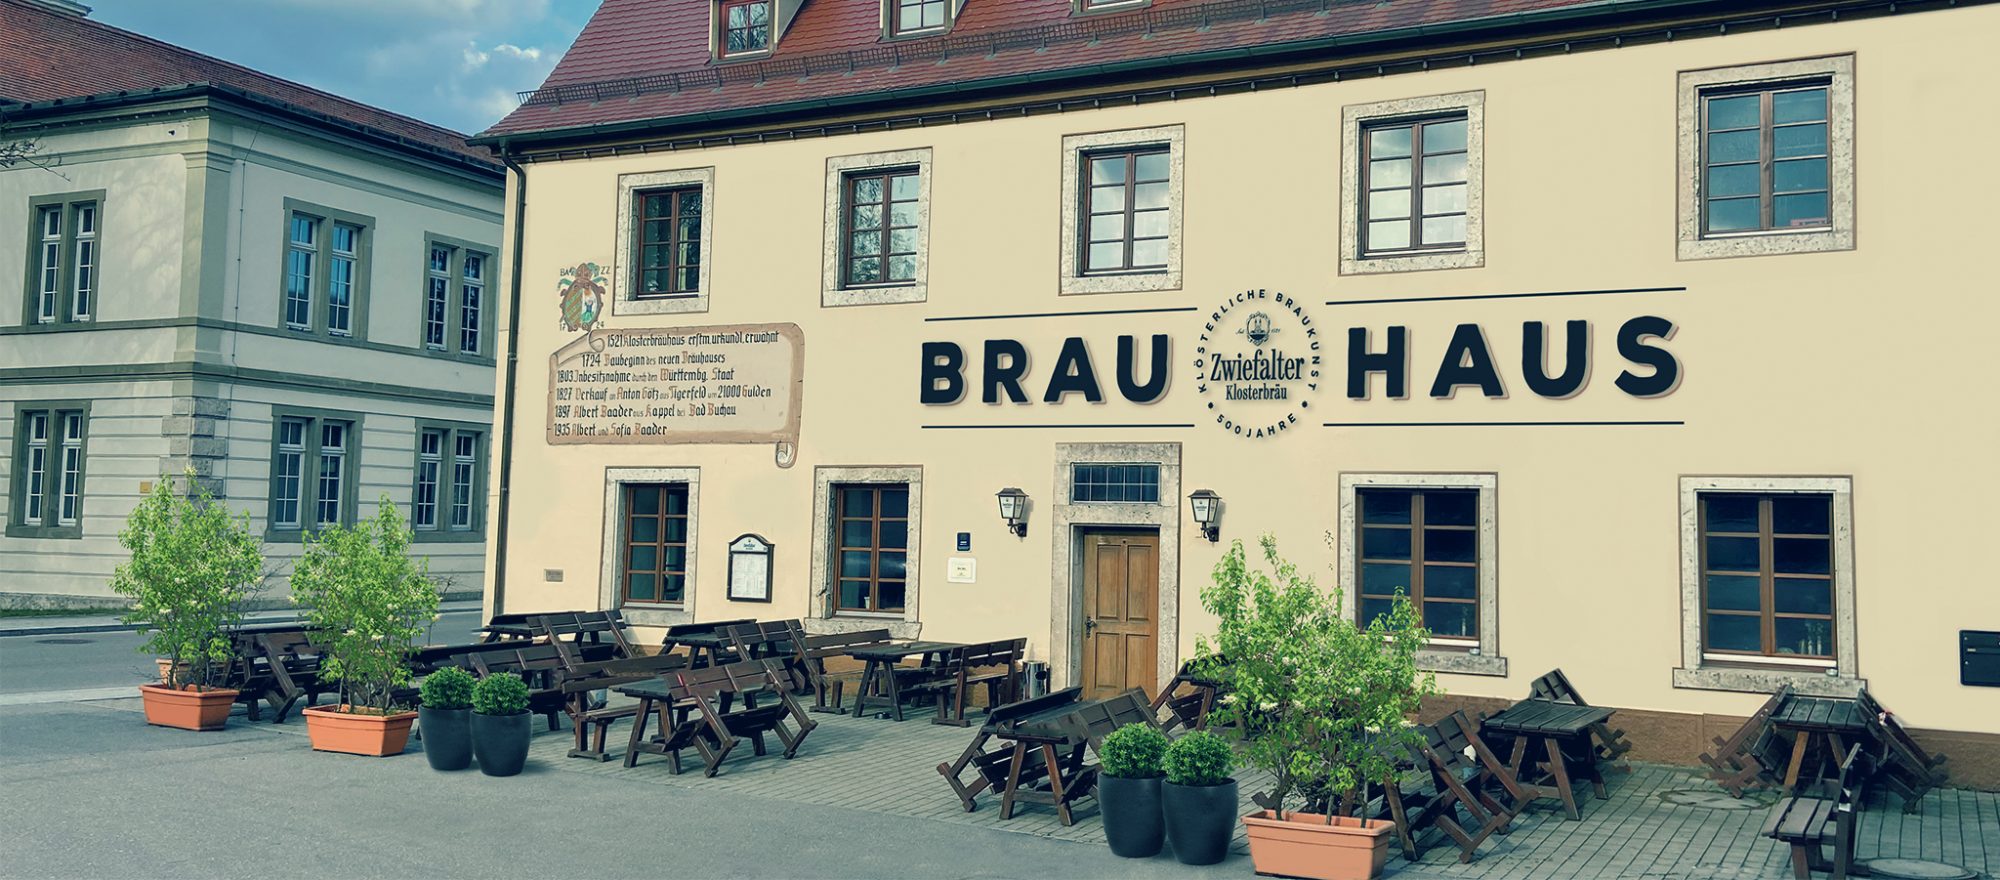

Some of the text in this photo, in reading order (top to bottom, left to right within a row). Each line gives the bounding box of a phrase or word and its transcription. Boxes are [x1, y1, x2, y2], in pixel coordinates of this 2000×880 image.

[607, 334, 623, 348] 1521
[1194, 289, 1320, 393] KLÖSTERLICHE BRAUKUNST
[582, 354, 601, 367] 1724
[604, 353, 645, 367] Baubeginn
[658, 355, 680, 365] neuen
[1210, 349, 1305, 382] Zwiefalter
[1347, 315, 1681, 398] HAUS
[711, 367, 735, 380] Staat
[920, 334, 1173, 404] BRAU
[556, 387, 573, 401] 1827
[575, 387, 608, 402] Verkauf
[617, 387, 641, 400] Anton
[668, 385, 707, 401] Tigerfeld
[717, 384, 741, 398] 21000
[742, 384, 772, 398] Gulden
[1226, 383, 1288, 401] Klosterbräu
[573, 405, 599, 418] Albert
[600, 404, 633, 418] Baader
[645, 403, 675, 419] Kappel
[689, 403, 706, 417] Bad
[707, 402, 737, 417] Buchau
[554, 423, 571, 437] 1935
[571, 423, 596, 436] Albert
[610, 422, 631, 437] Sofia
[634, 422, 668, 436] Baader
[1216, 412, 1297, 439] 500 JAHRE
